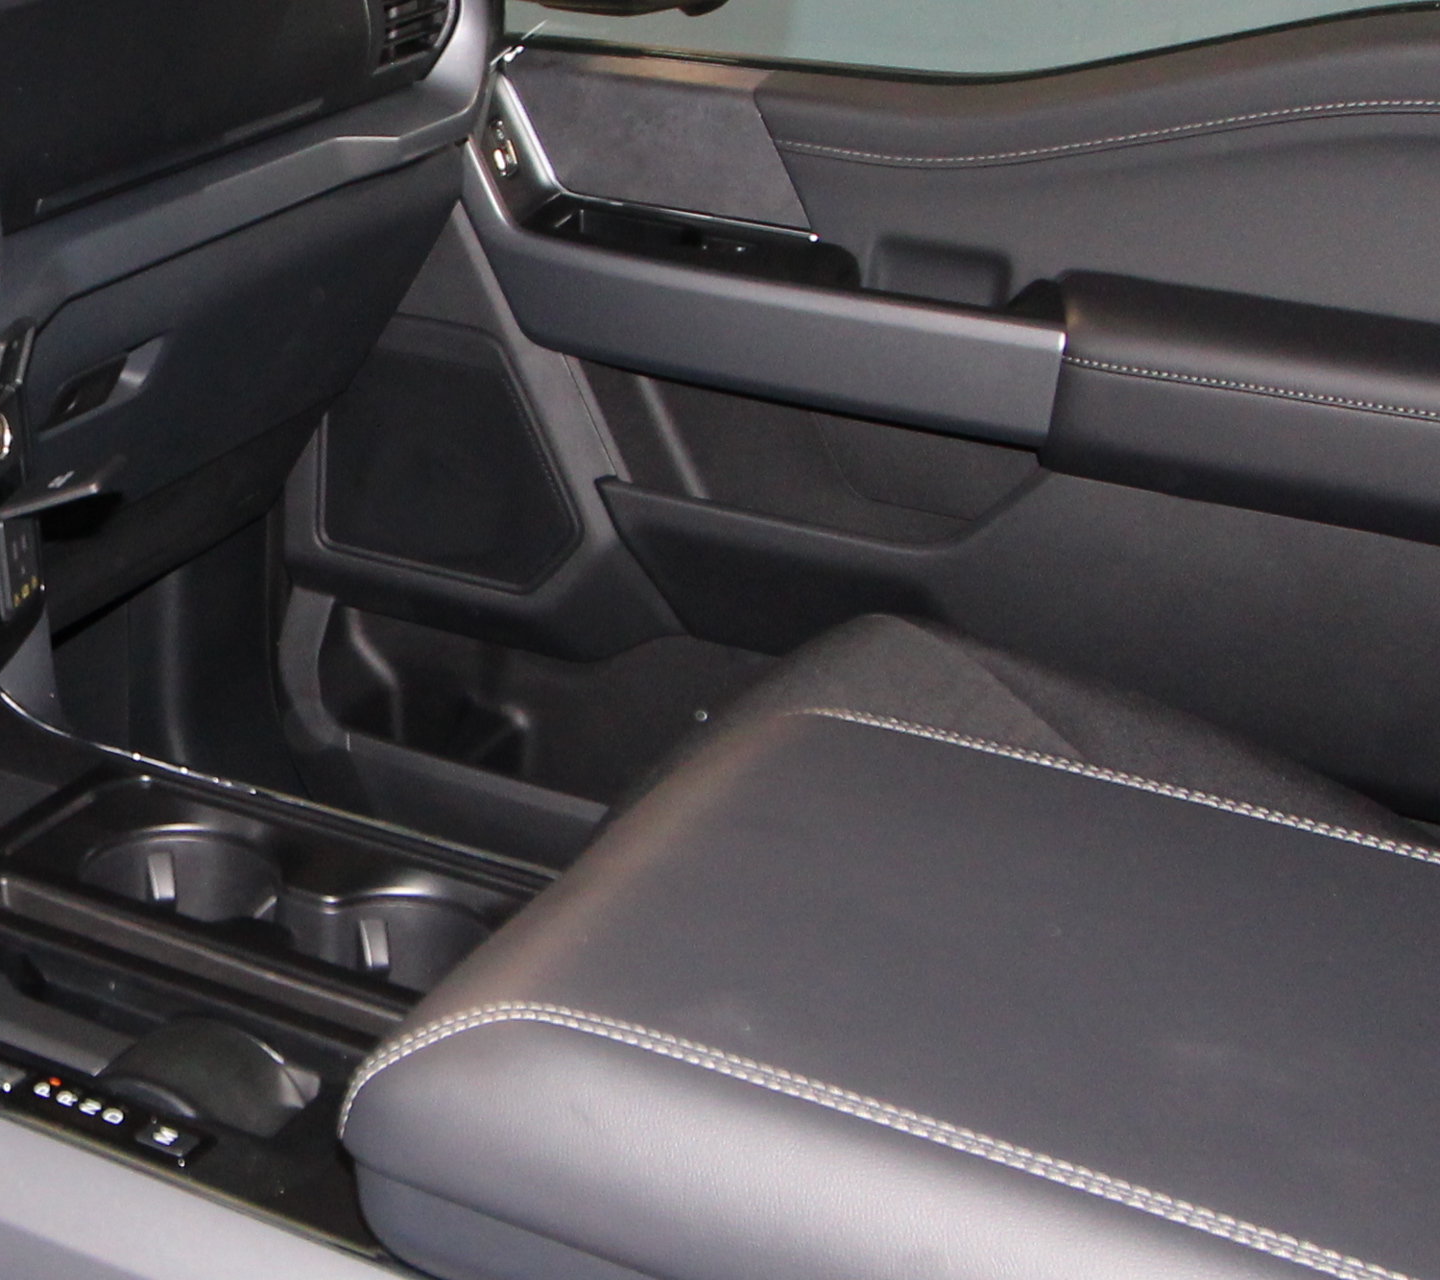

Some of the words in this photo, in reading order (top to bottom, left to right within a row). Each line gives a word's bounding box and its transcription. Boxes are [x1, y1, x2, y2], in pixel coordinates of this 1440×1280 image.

[33, 1081, 51, 1098] P
[56, 1090, 78, 1107] R
[79, 1098, 102, 1116] N
[102, 1107, 124, 1125] D
[154, 1126, 178, 1145] M
